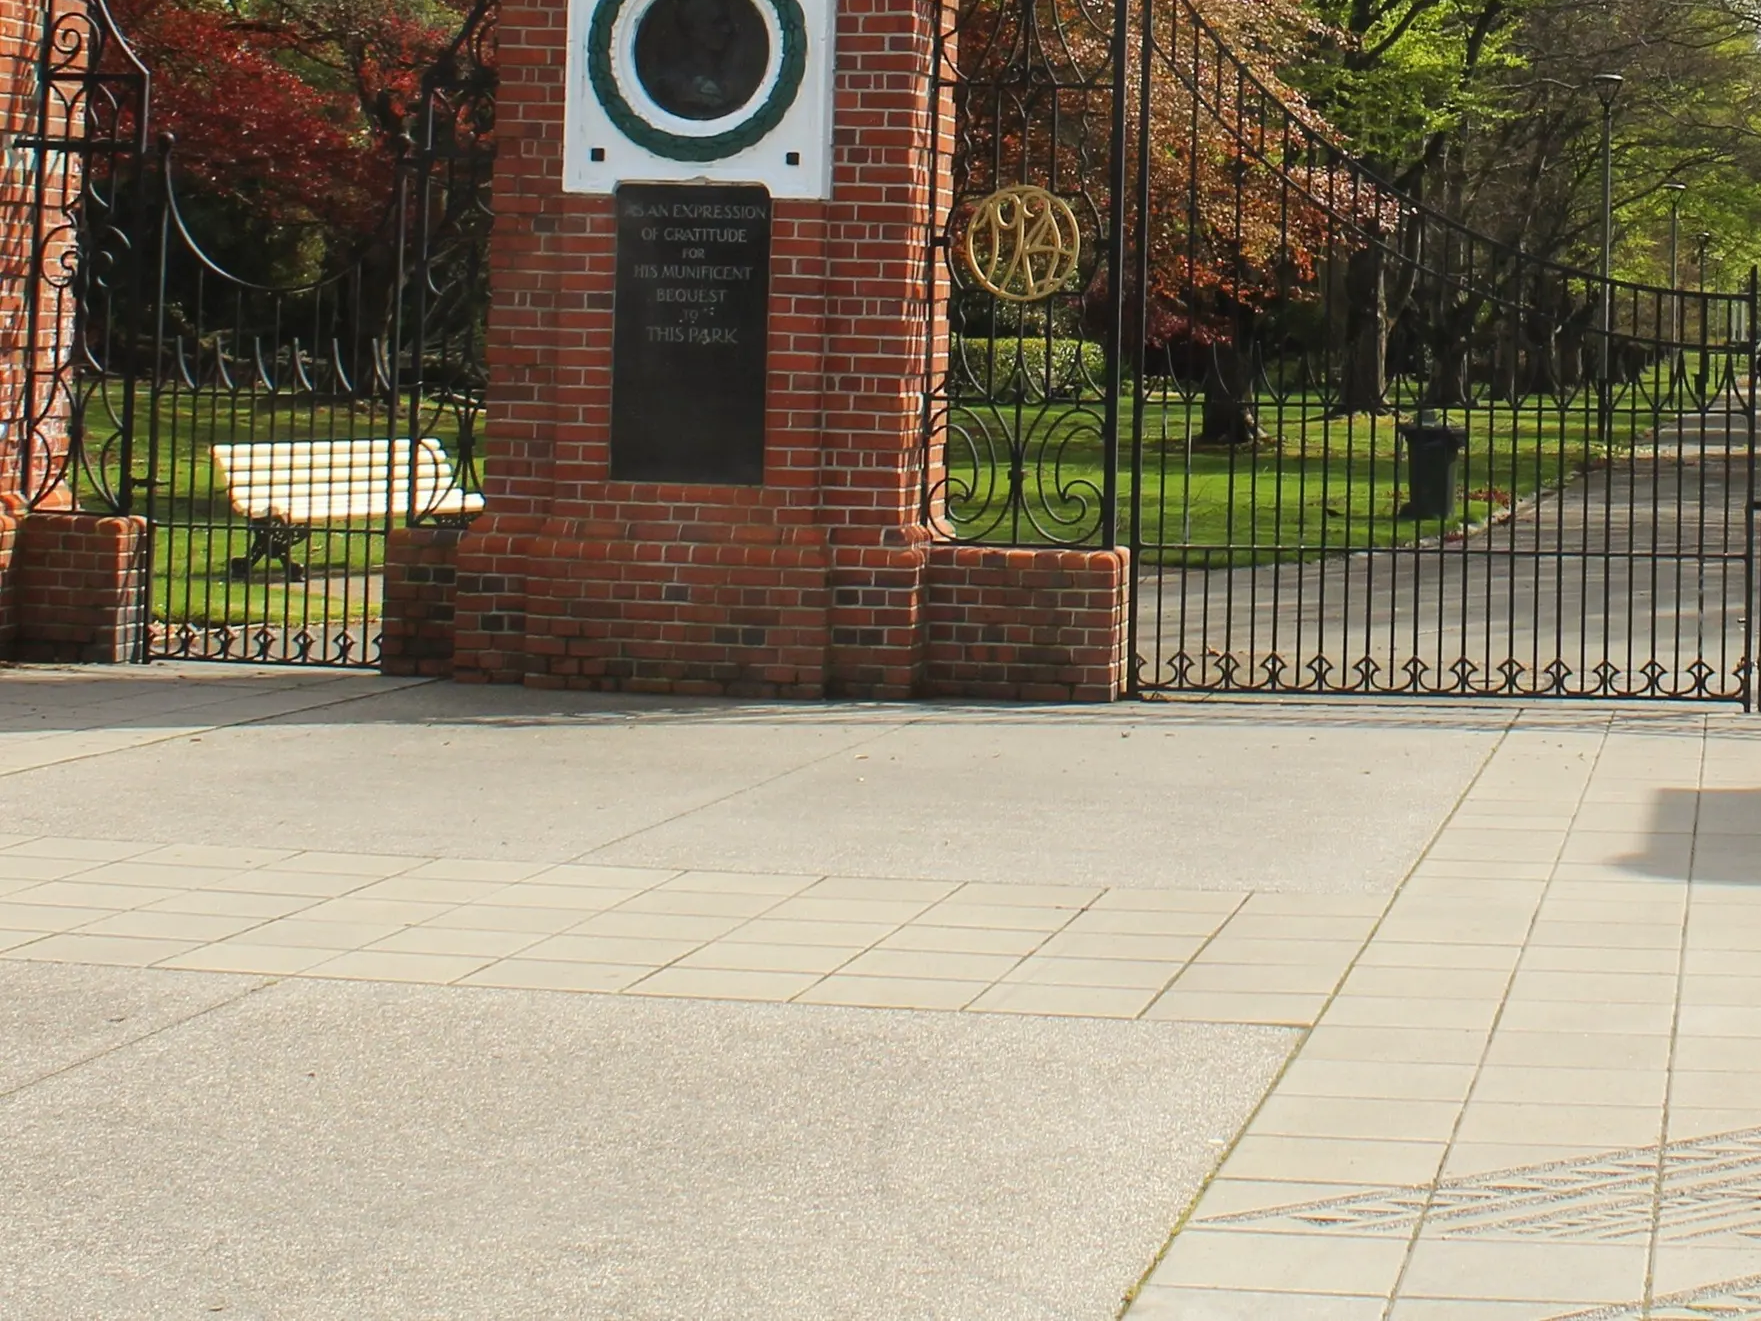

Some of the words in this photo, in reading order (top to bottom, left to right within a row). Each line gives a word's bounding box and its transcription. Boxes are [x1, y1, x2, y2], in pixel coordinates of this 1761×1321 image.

[625, 204, 643, 217] AS
[648, 205, 668, 217] AN
[673, 204, 766, 219] EXPRESSION
[641, 227, 659, 240] OF
[664, 227, 747, 243] GRATITUDE
[682, 248, 705, 259] FOR
[634, 265, 658, 278] HIS
[661, 265, 753, 280] MUNIFICENT
[656, 289, 727, 303] BEQUEST
[683, 310, 699, 320] TO
[646, 327, 685, 342] THIS
[689, 328, 739, 344] PARK
